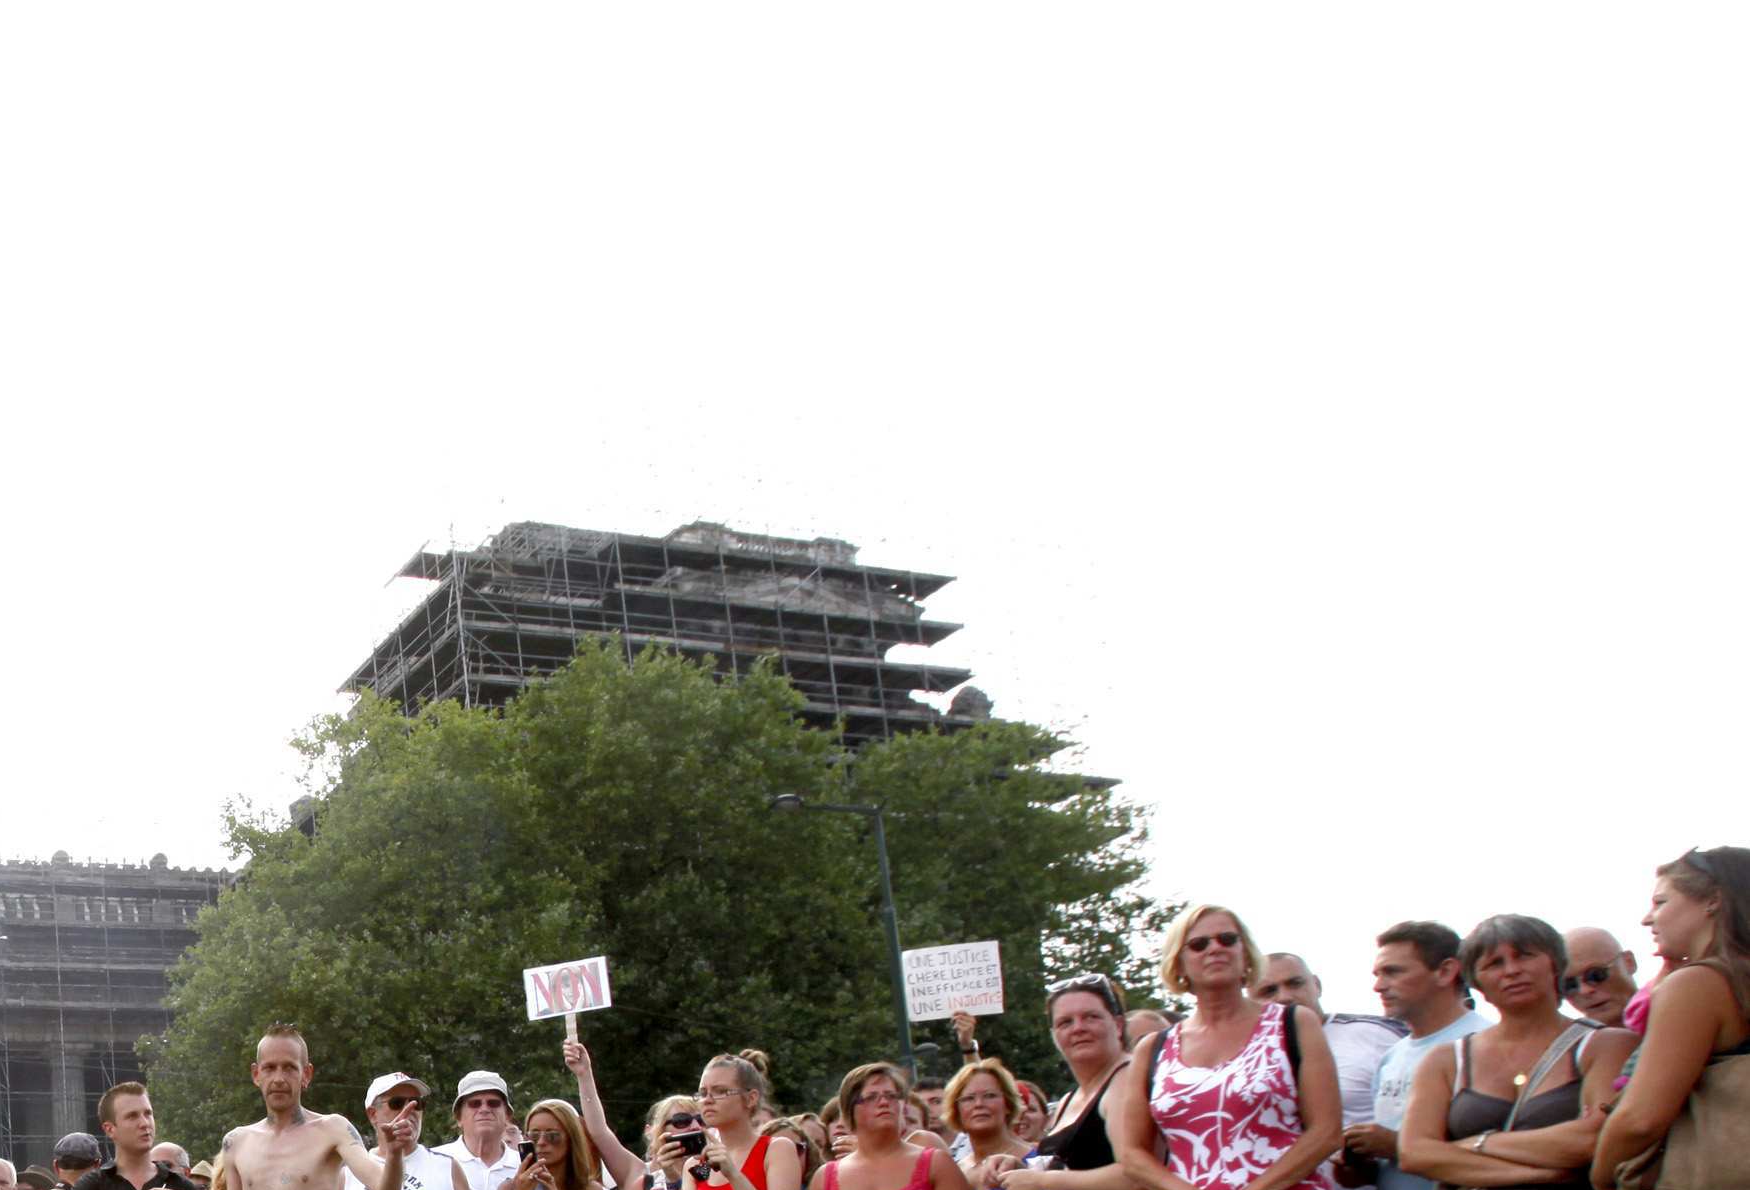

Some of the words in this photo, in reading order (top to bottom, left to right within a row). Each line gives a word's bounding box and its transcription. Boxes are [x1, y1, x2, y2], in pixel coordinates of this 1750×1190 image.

[937, 949, 990, 966] JUSTICE
[907, 969, 947, 985] CHERE
[531, 961, 605, 1017] NON
[911, 981, 983, 997] INEFFICACE
[912, 999, 944, 1015] UNE
